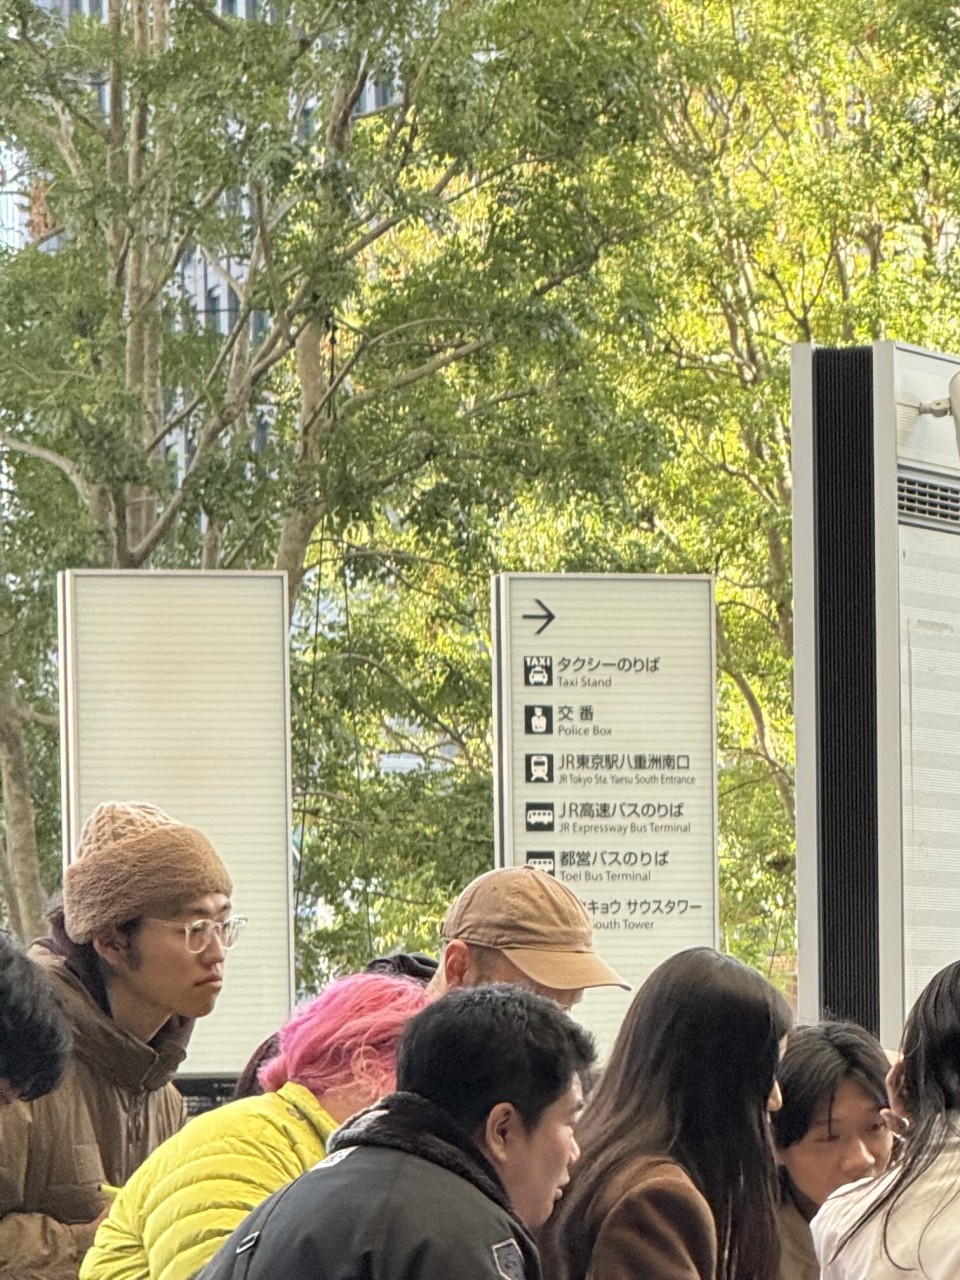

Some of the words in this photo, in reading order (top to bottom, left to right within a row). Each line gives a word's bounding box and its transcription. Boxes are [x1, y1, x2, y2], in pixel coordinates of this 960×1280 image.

[525, 656, 551, 667] TAXI
[558, 656, 660, 672] タクシーのりば
[557, 676, 578, 687] Taxi
[580, 676, 612, 687] Stand
[557, 704, 594, 721] 交番
[558, 725, 590, 735] Police
[593, 725, 612, 735] Box
[558, 753, 690, 770] JR東京駅八重洲南口
[558, 774, 568, 784] JR
[569, 774, 593, 787] Tokyo
[594, 774, 609, 784] Sta.
[610, 774, 634, 784] Yaesu
[635, 774, 659, 784] South
[660, 774, 696, 784] Entrance
[558, 802, 684, 818] JR高速バスのりば
[559, 822, 570, 833] JR
[572, 822, 628, 835] Expressway
[630, 822, 648, 833] Bus
[650, 822, 691, 833] Terminal
[560, 851, 669, 867] 都営バスのりば
[561, 871, 582, 881] Toei
[584, 871, 604, 881] Bus
[606, 871, 651, 881] Terminal
[626, 899, 702, 915] サウスタワー
[593, 920, 620, 930] outh
[622, 920, 654, 930] Tower
